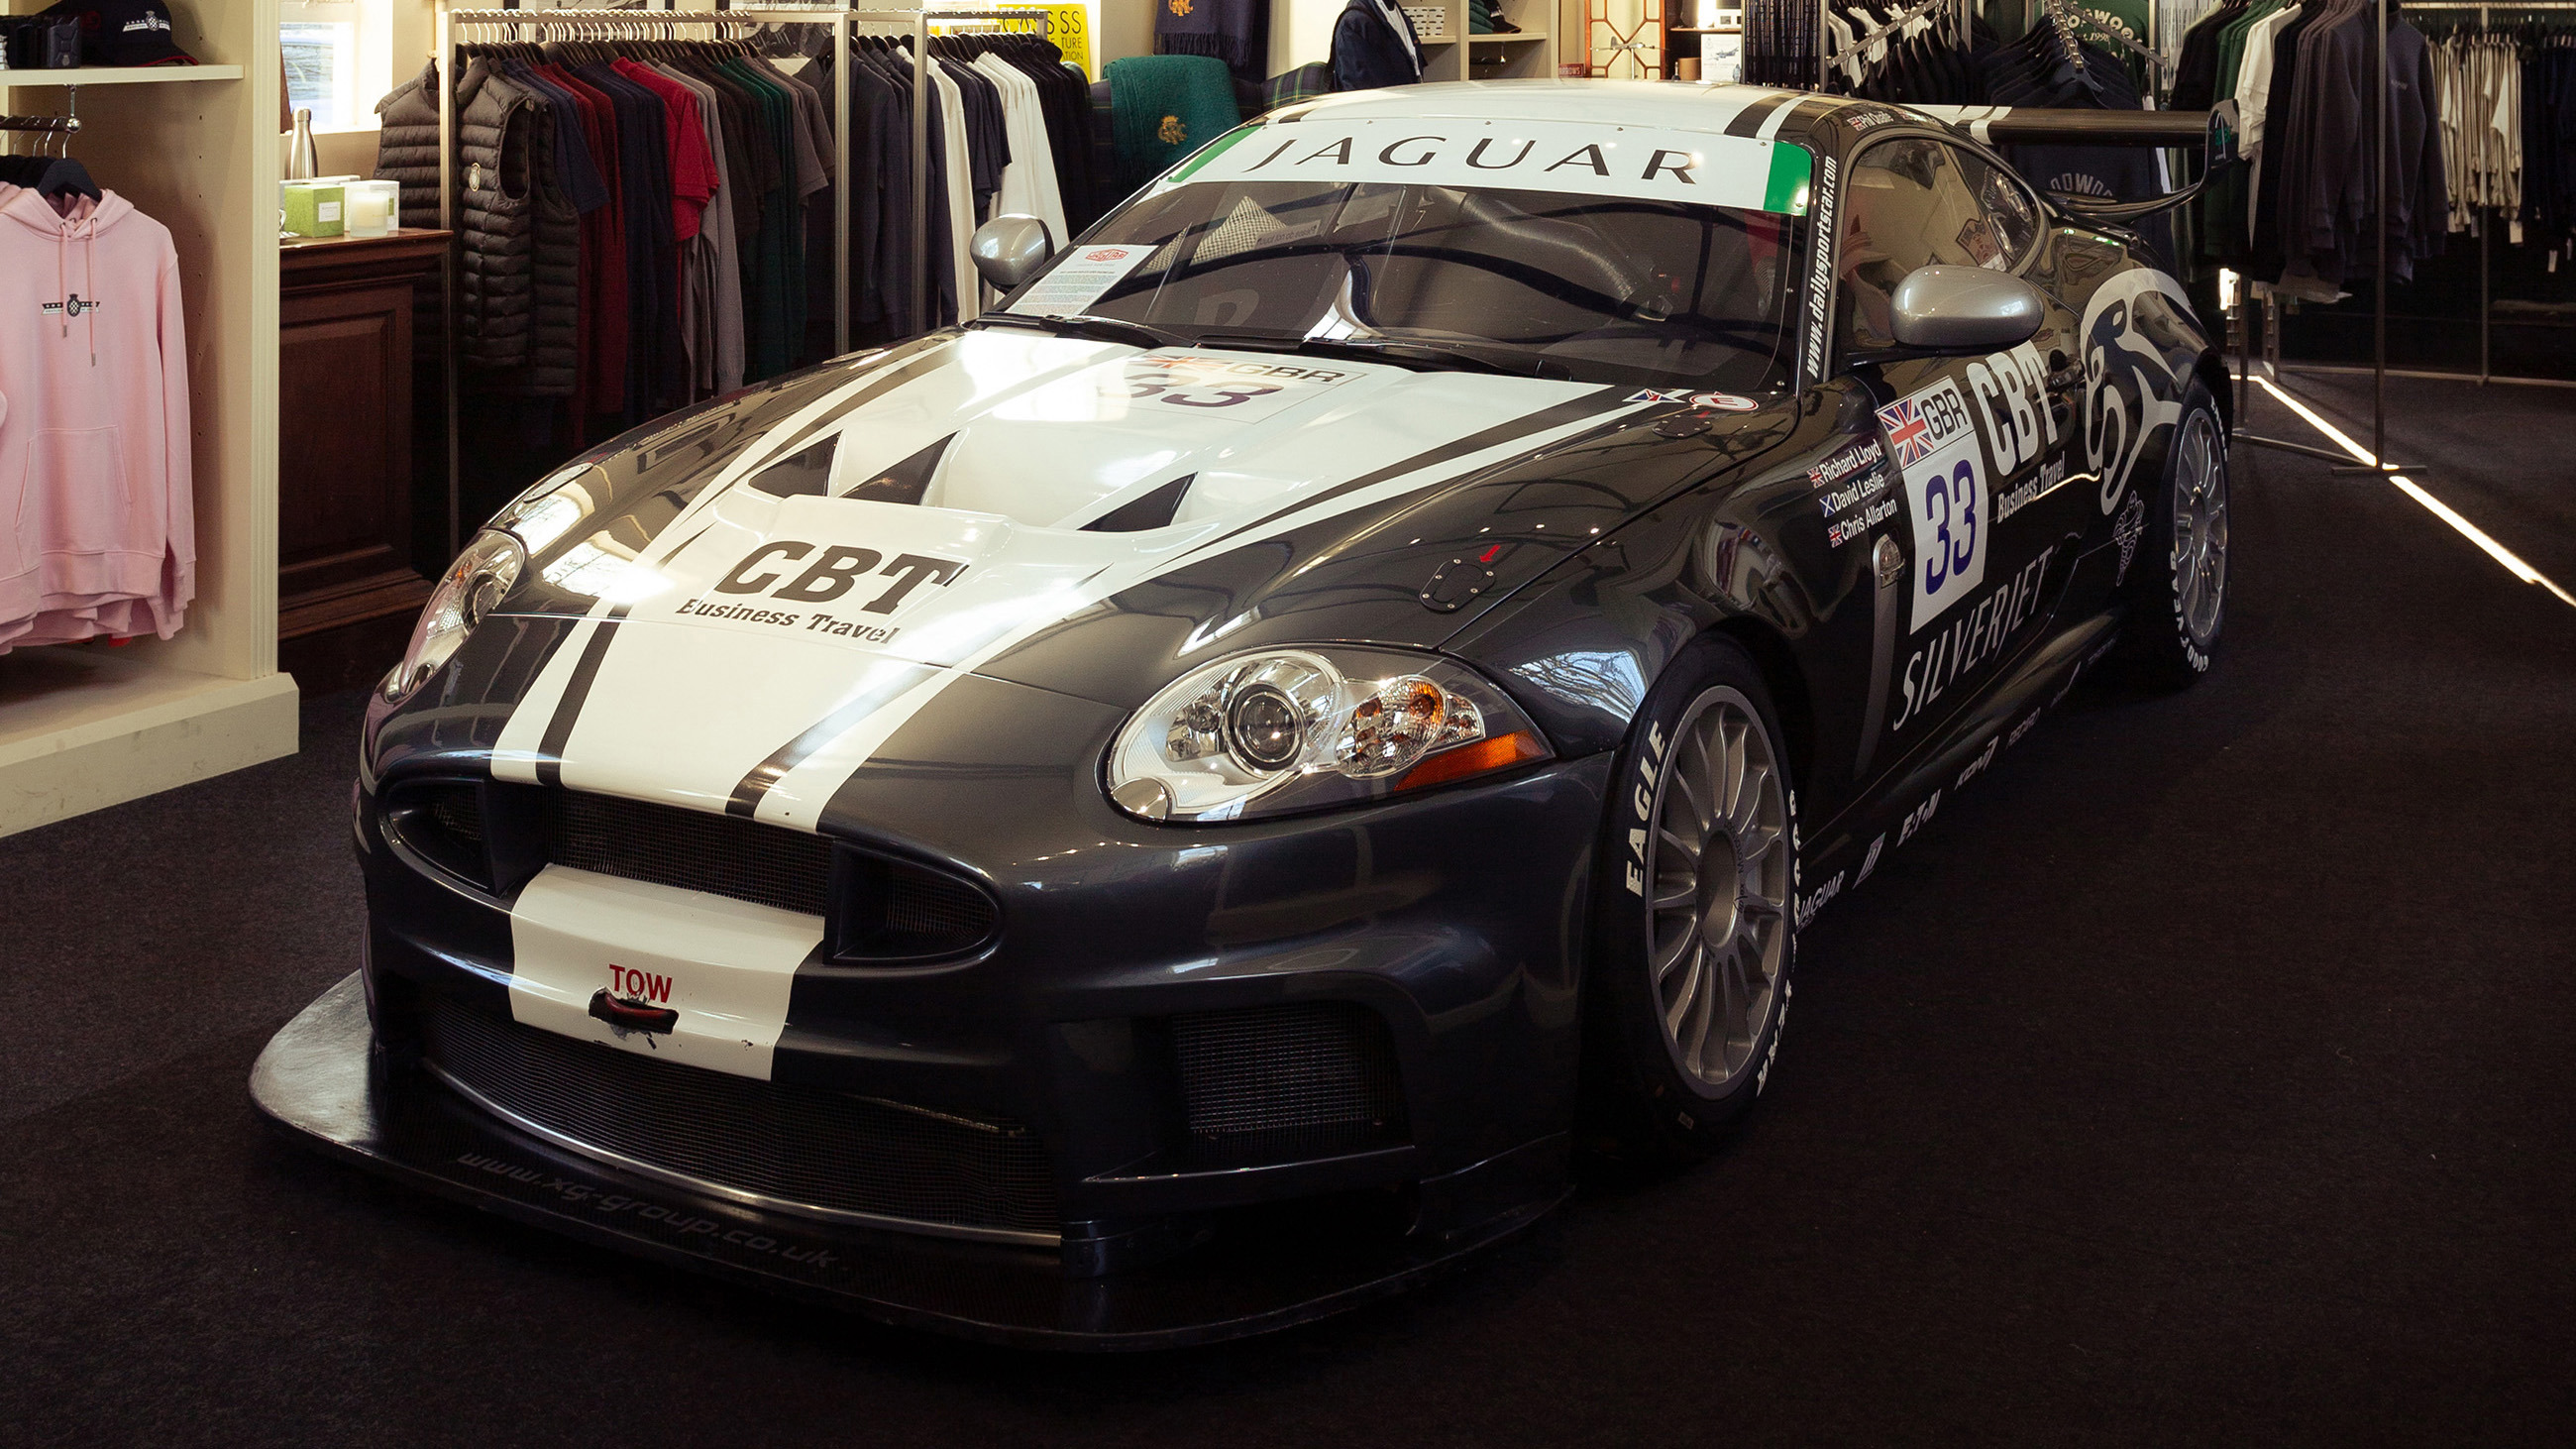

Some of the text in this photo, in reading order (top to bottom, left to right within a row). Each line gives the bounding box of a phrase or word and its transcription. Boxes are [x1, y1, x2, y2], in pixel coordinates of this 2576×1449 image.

[1241, 136, 1697, 184] JAGUAR
[1807, 156, 1837, 380] www.dailysportscar.com
[1125, 374, 1285, 408] 33
[1229, 363, 1345, 383] GBR
[1920, 388, 1969, 441] GBR
[1966, 340, 2059, 477] CBT
[1819, 439, 1882, 483] Richard Lloyd
[1831, 471, 1885, 512] David Leslie
[1997, 451, 2066, 524] Business Travel
[1840, 499, 1897, 541] Chris Allarton
[1925, 459, 1977, 596] 33
[713, 541, 970, 615] CBT
[676, 599, 901, 644] Business Travel
[1893, 545, 2055, 731] SILVERJET
[1626, 721, 1665, 897] EAGLE
[609, 963, 673, 1003] TOW
